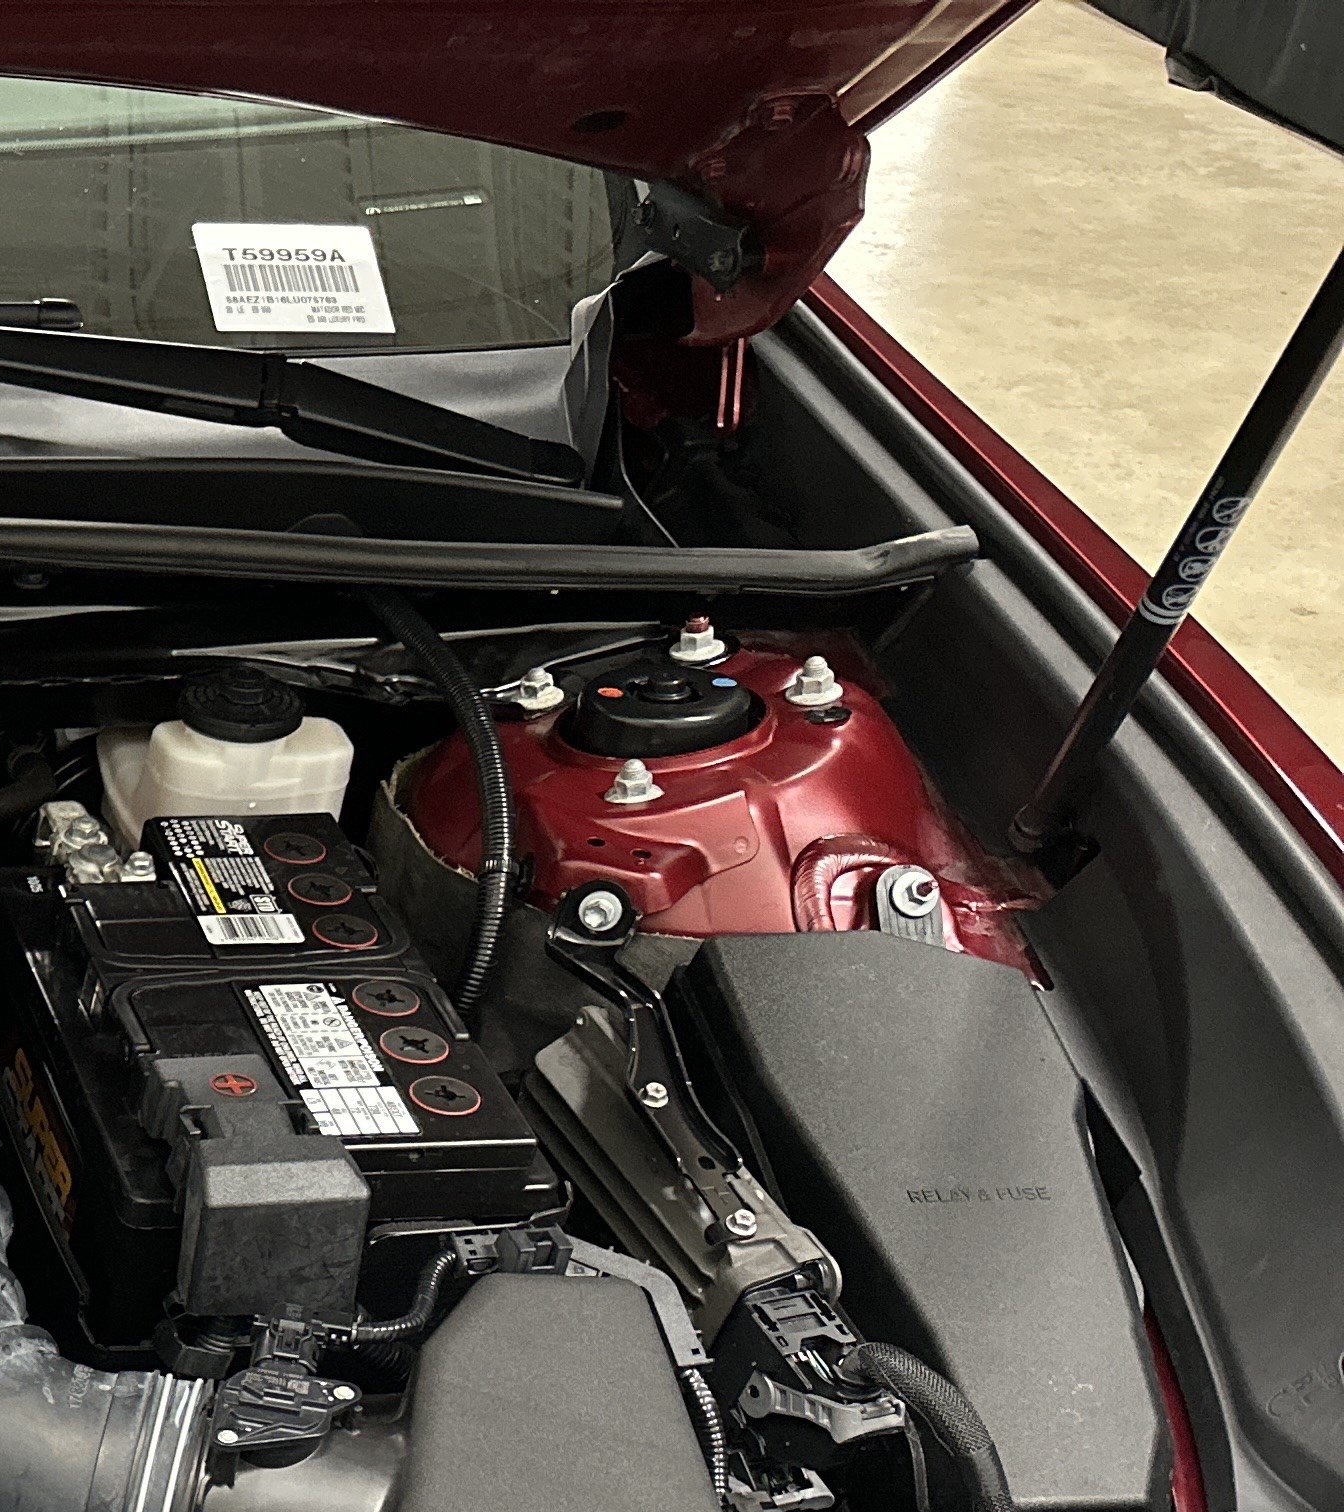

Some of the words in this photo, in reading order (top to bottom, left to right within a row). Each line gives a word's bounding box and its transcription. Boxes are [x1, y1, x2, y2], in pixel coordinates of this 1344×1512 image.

[222, 247, 346, 262] T59959A
[906, 1187, 971, 1203] RELAY
[977, 1187, 992, 1201] &
[995, 1186, 1052, 1201] FUSE
